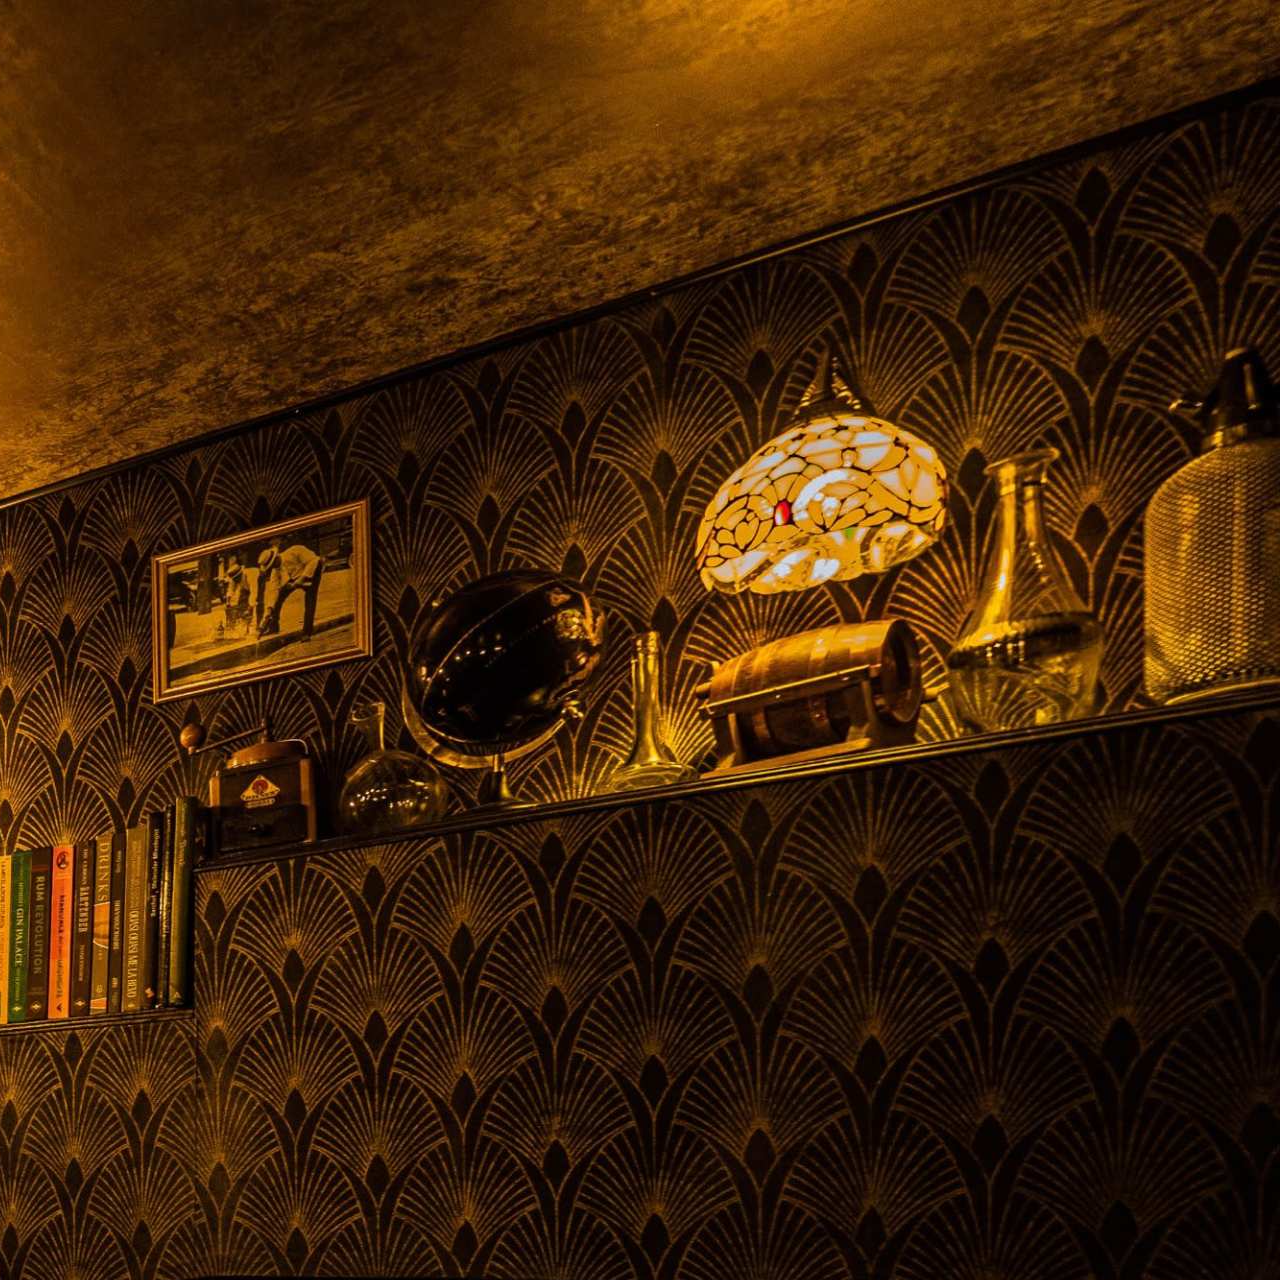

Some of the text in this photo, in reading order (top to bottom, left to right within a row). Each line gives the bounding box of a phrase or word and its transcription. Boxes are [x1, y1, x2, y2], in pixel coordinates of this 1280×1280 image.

[96, 842, 111, 903] DRINKS
[15, 908, 25, 926] GIN
[33, 875, 45, 974] RUM REVOLUTION
[78, 886, 90, 933] BARTENDER
[14, 928, 24, 968] PALACE
